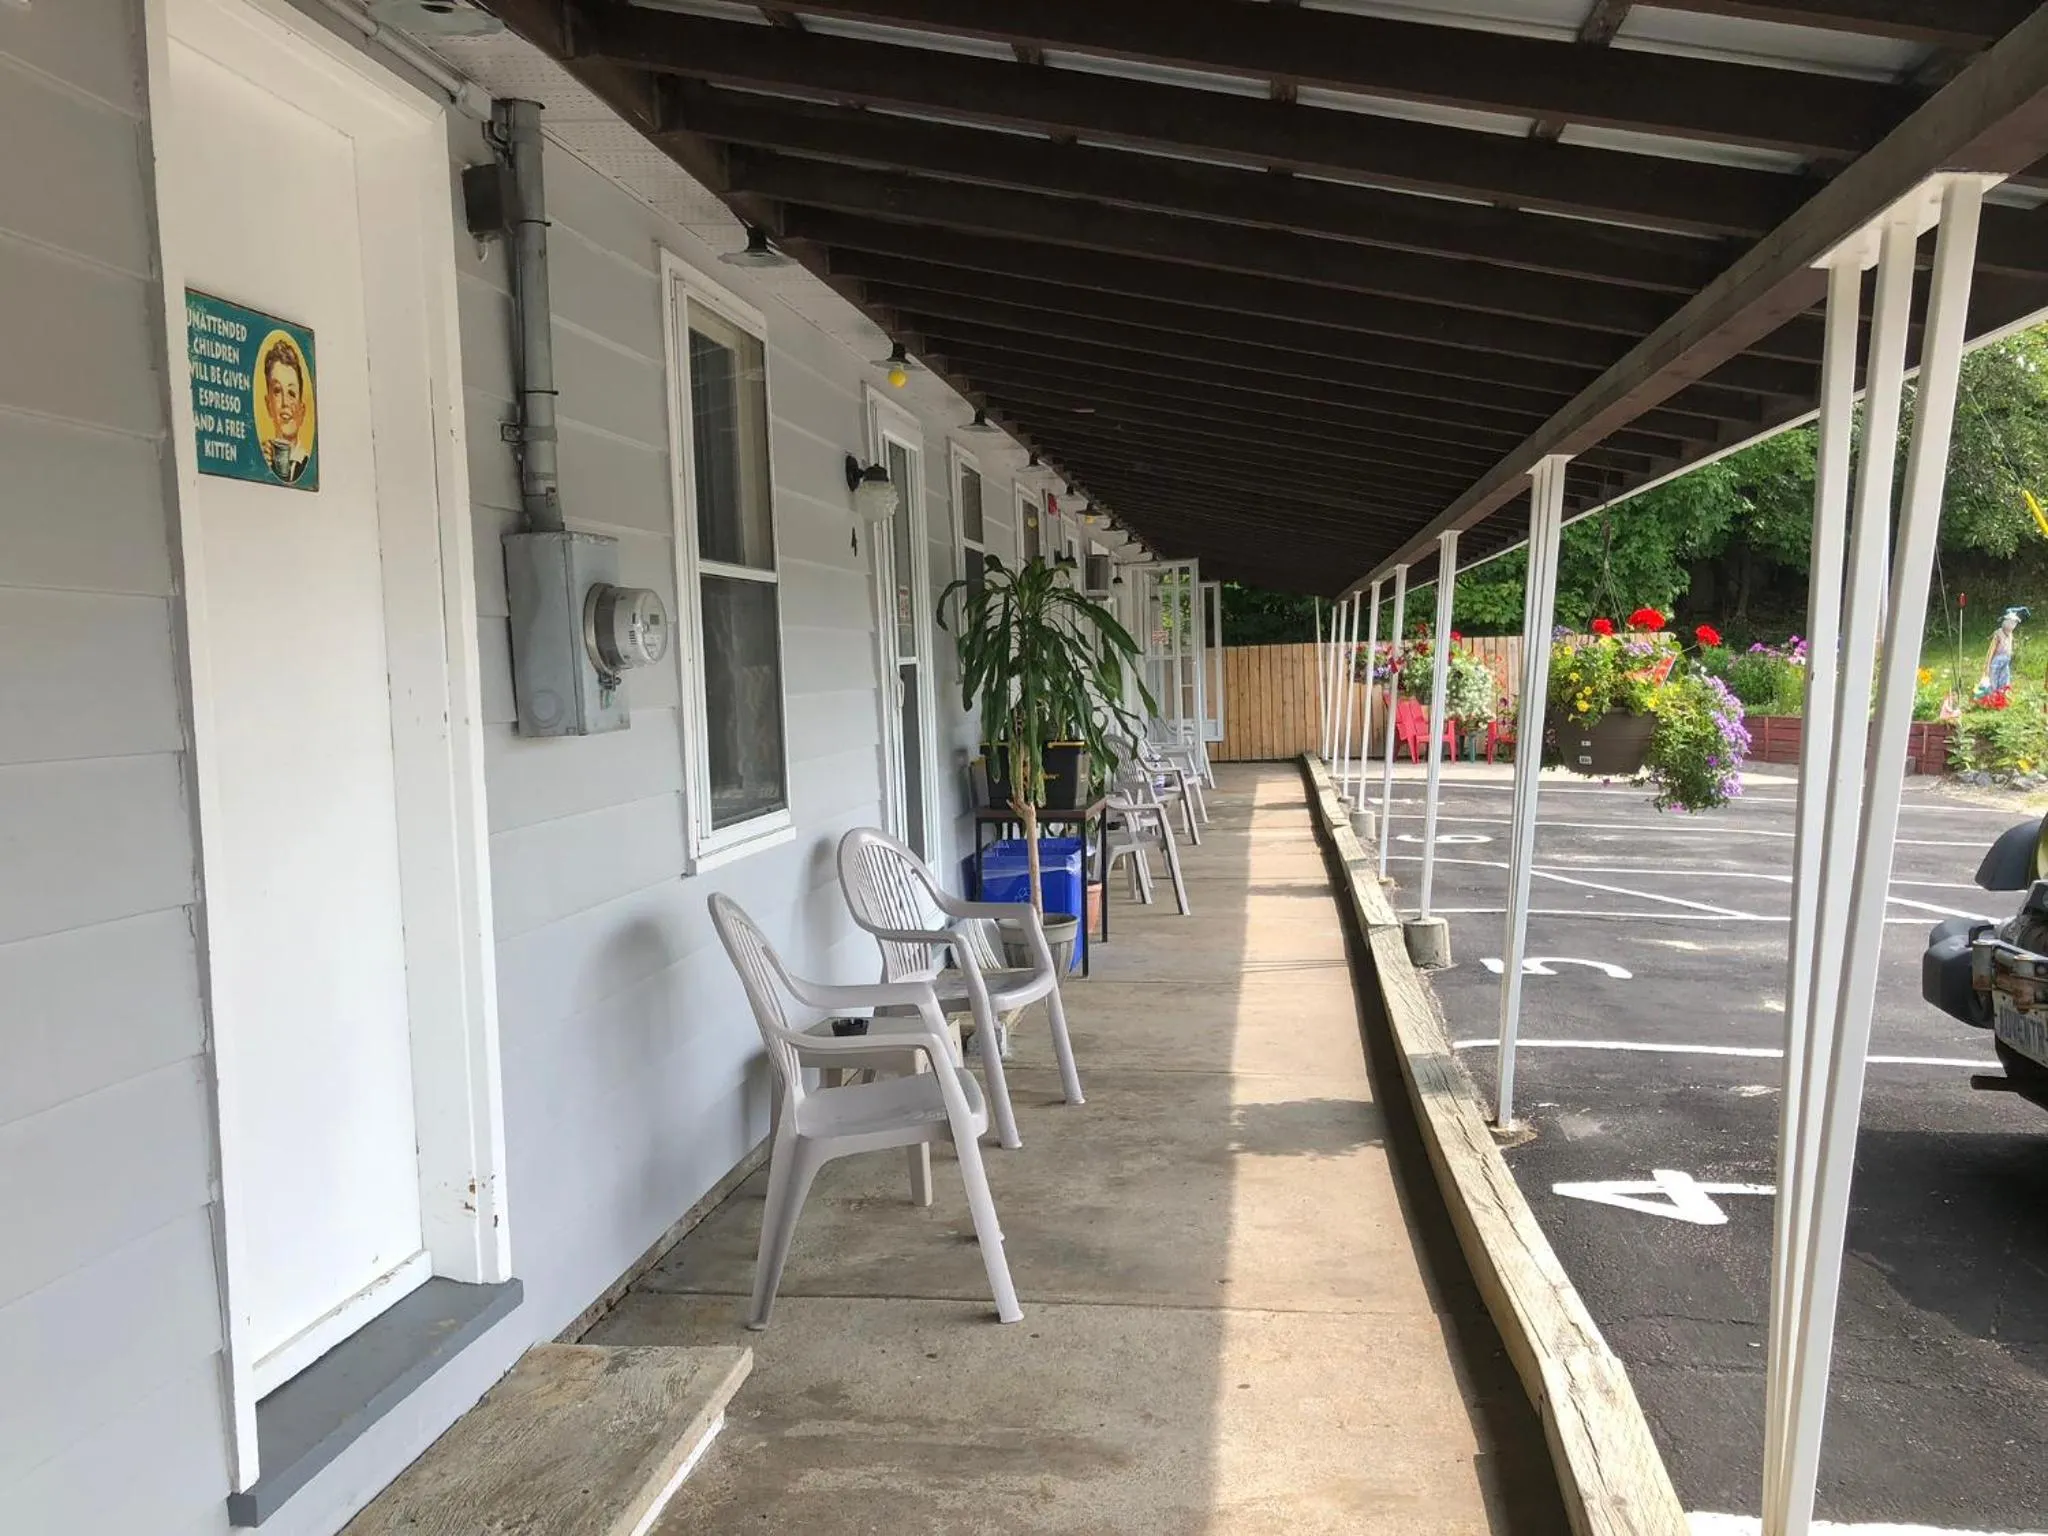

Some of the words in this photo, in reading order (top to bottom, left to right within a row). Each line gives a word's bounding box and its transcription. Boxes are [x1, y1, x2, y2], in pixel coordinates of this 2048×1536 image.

[193, 336, 240, 365] CHILDREN
[210, 365, 221, 385] BE
[223, 369, 250, 391] GIVEN
[199, 387, 241, 414] ESPRESSO
[216, 418, 224, 435] A
[225, 418, 245, 439] FREE
[204, 439, 237, 462] KITTEN
[1480, 956, 1633, 980] 5
[1552, 1168, 1777, 1225] 4
